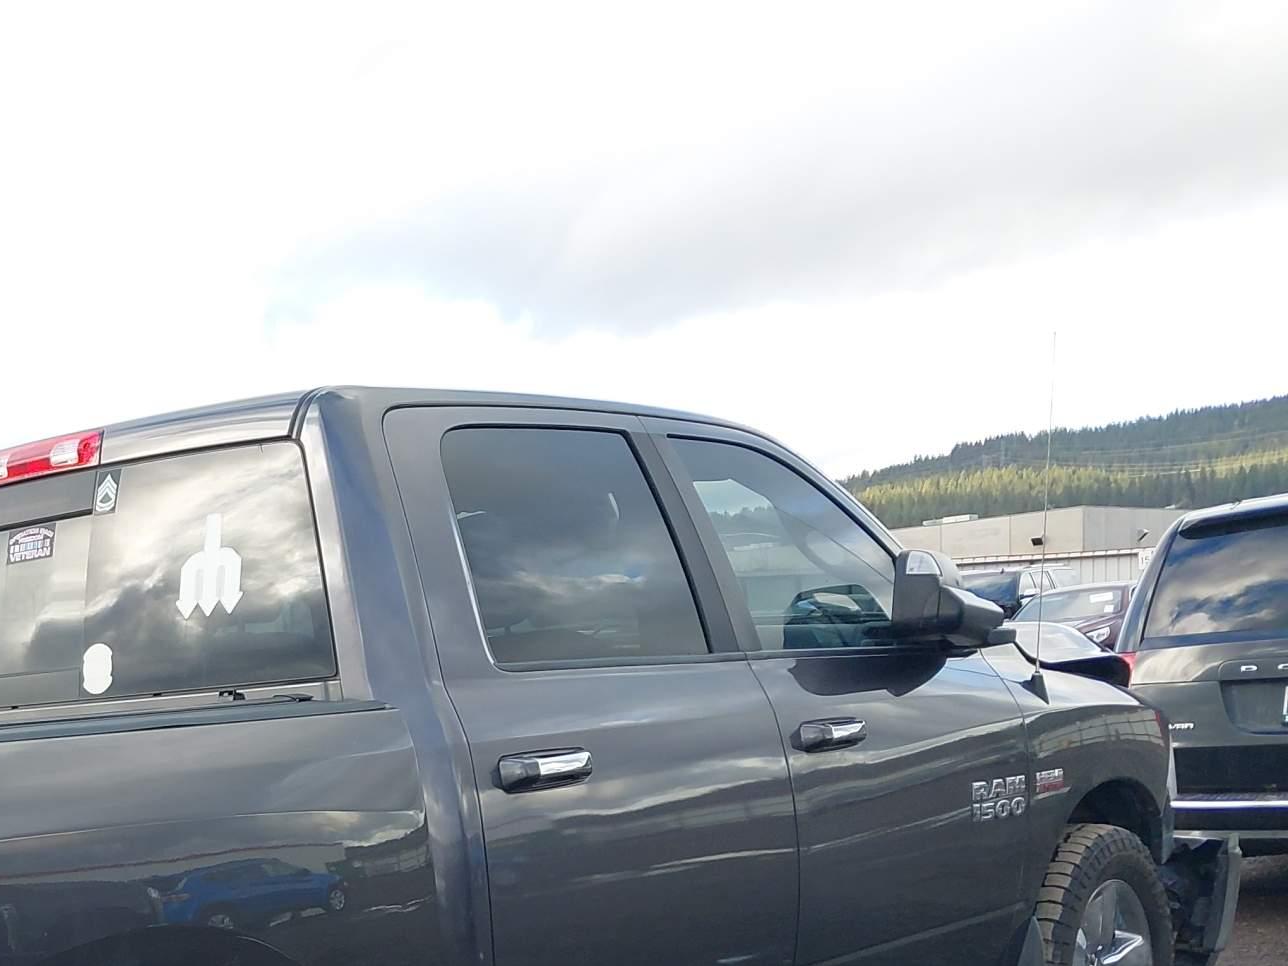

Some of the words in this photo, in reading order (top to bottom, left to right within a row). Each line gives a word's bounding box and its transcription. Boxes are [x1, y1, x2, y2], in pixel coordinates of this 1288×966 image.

[9, 546, 51, 562] VETERAN
[971, 774, 1027, 801] RAM
[971, 796, 1027, 822] 1500
